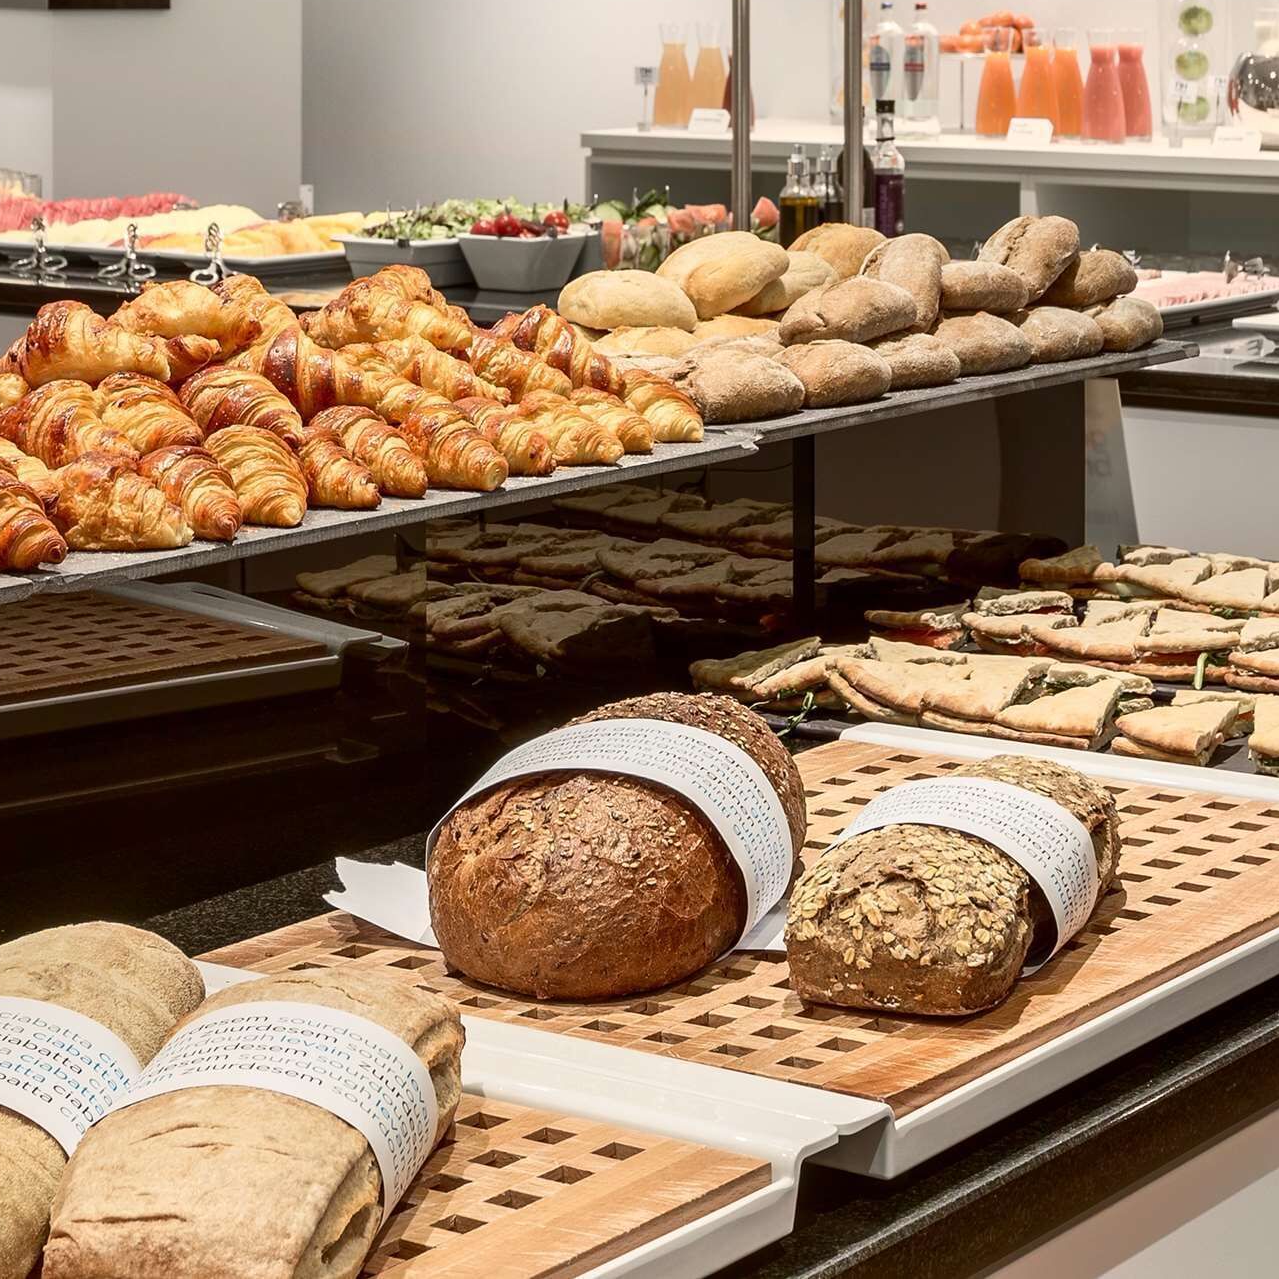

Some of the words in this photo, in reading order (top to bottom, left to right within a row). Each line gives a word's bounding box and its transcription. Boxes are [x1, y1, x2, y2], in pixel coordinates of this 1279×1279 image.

[32, 1031, 118, 1092] ciabatta
[279, 1017, 404, 1071] sourdough
[280, 1034, 351, 1060] levain
[20, 1054, 105, 1116] ciabatta
[179, 1062, 323, 1086] zuurdesem
[238, 1053, 372, 1100] sourdough
